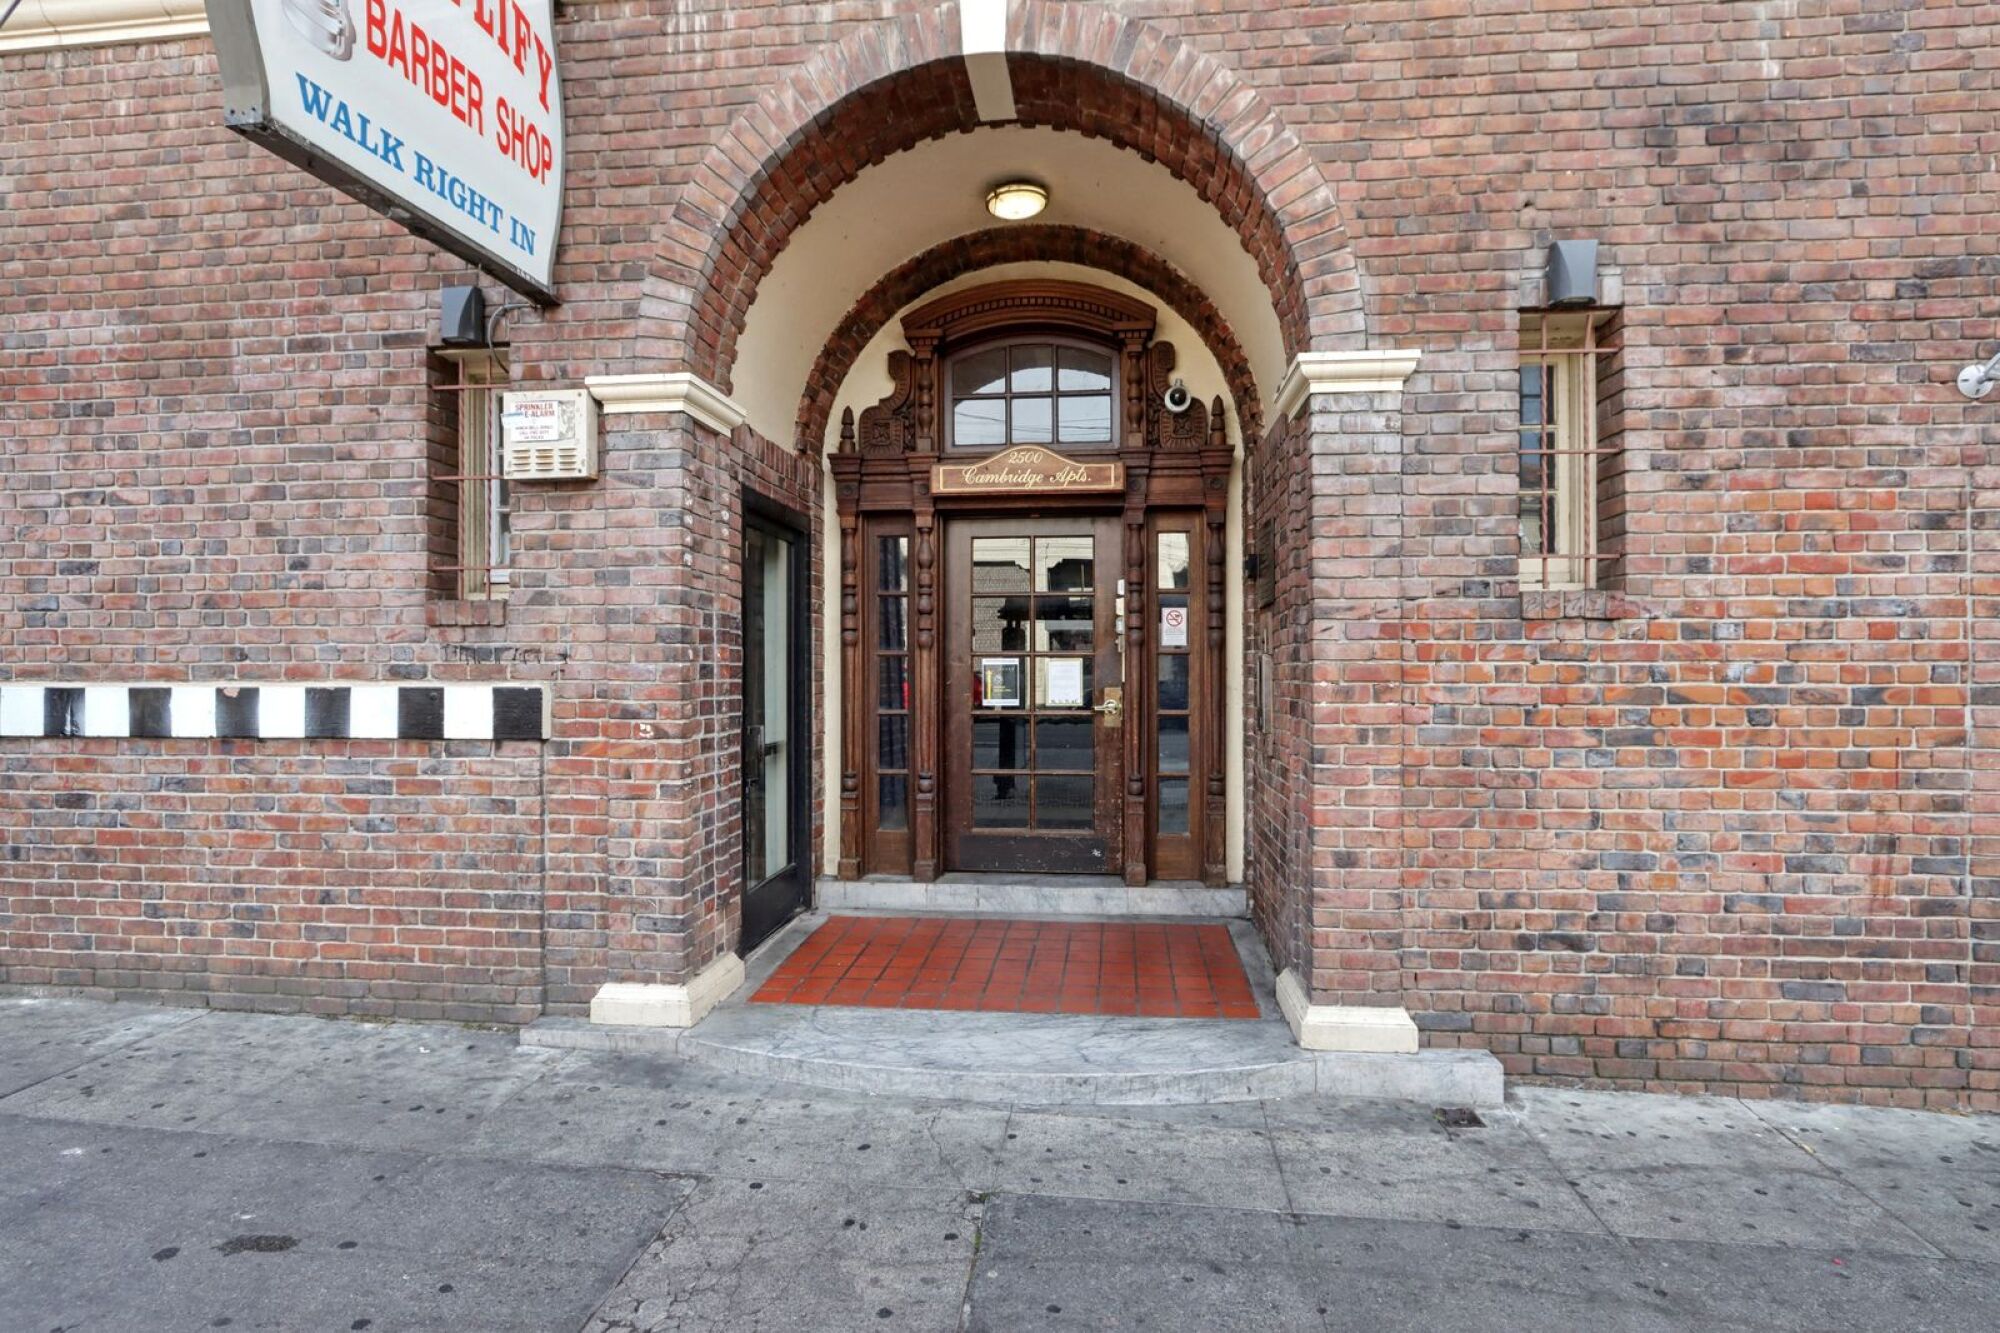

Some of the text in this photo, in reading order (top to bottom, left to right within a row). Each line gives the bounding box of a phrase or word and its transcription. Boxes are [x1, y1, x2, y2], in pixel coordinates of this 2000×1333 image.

[366, 0, 553, 185] BARBER SHOP
[453, 0, 553, 114] LIFY
[295, 72, 536, 256] WALK RIGHT IN
[962, 466, 1092, 488] Cambridge Apts.
[1008, 452, 1043, 464] 2500
